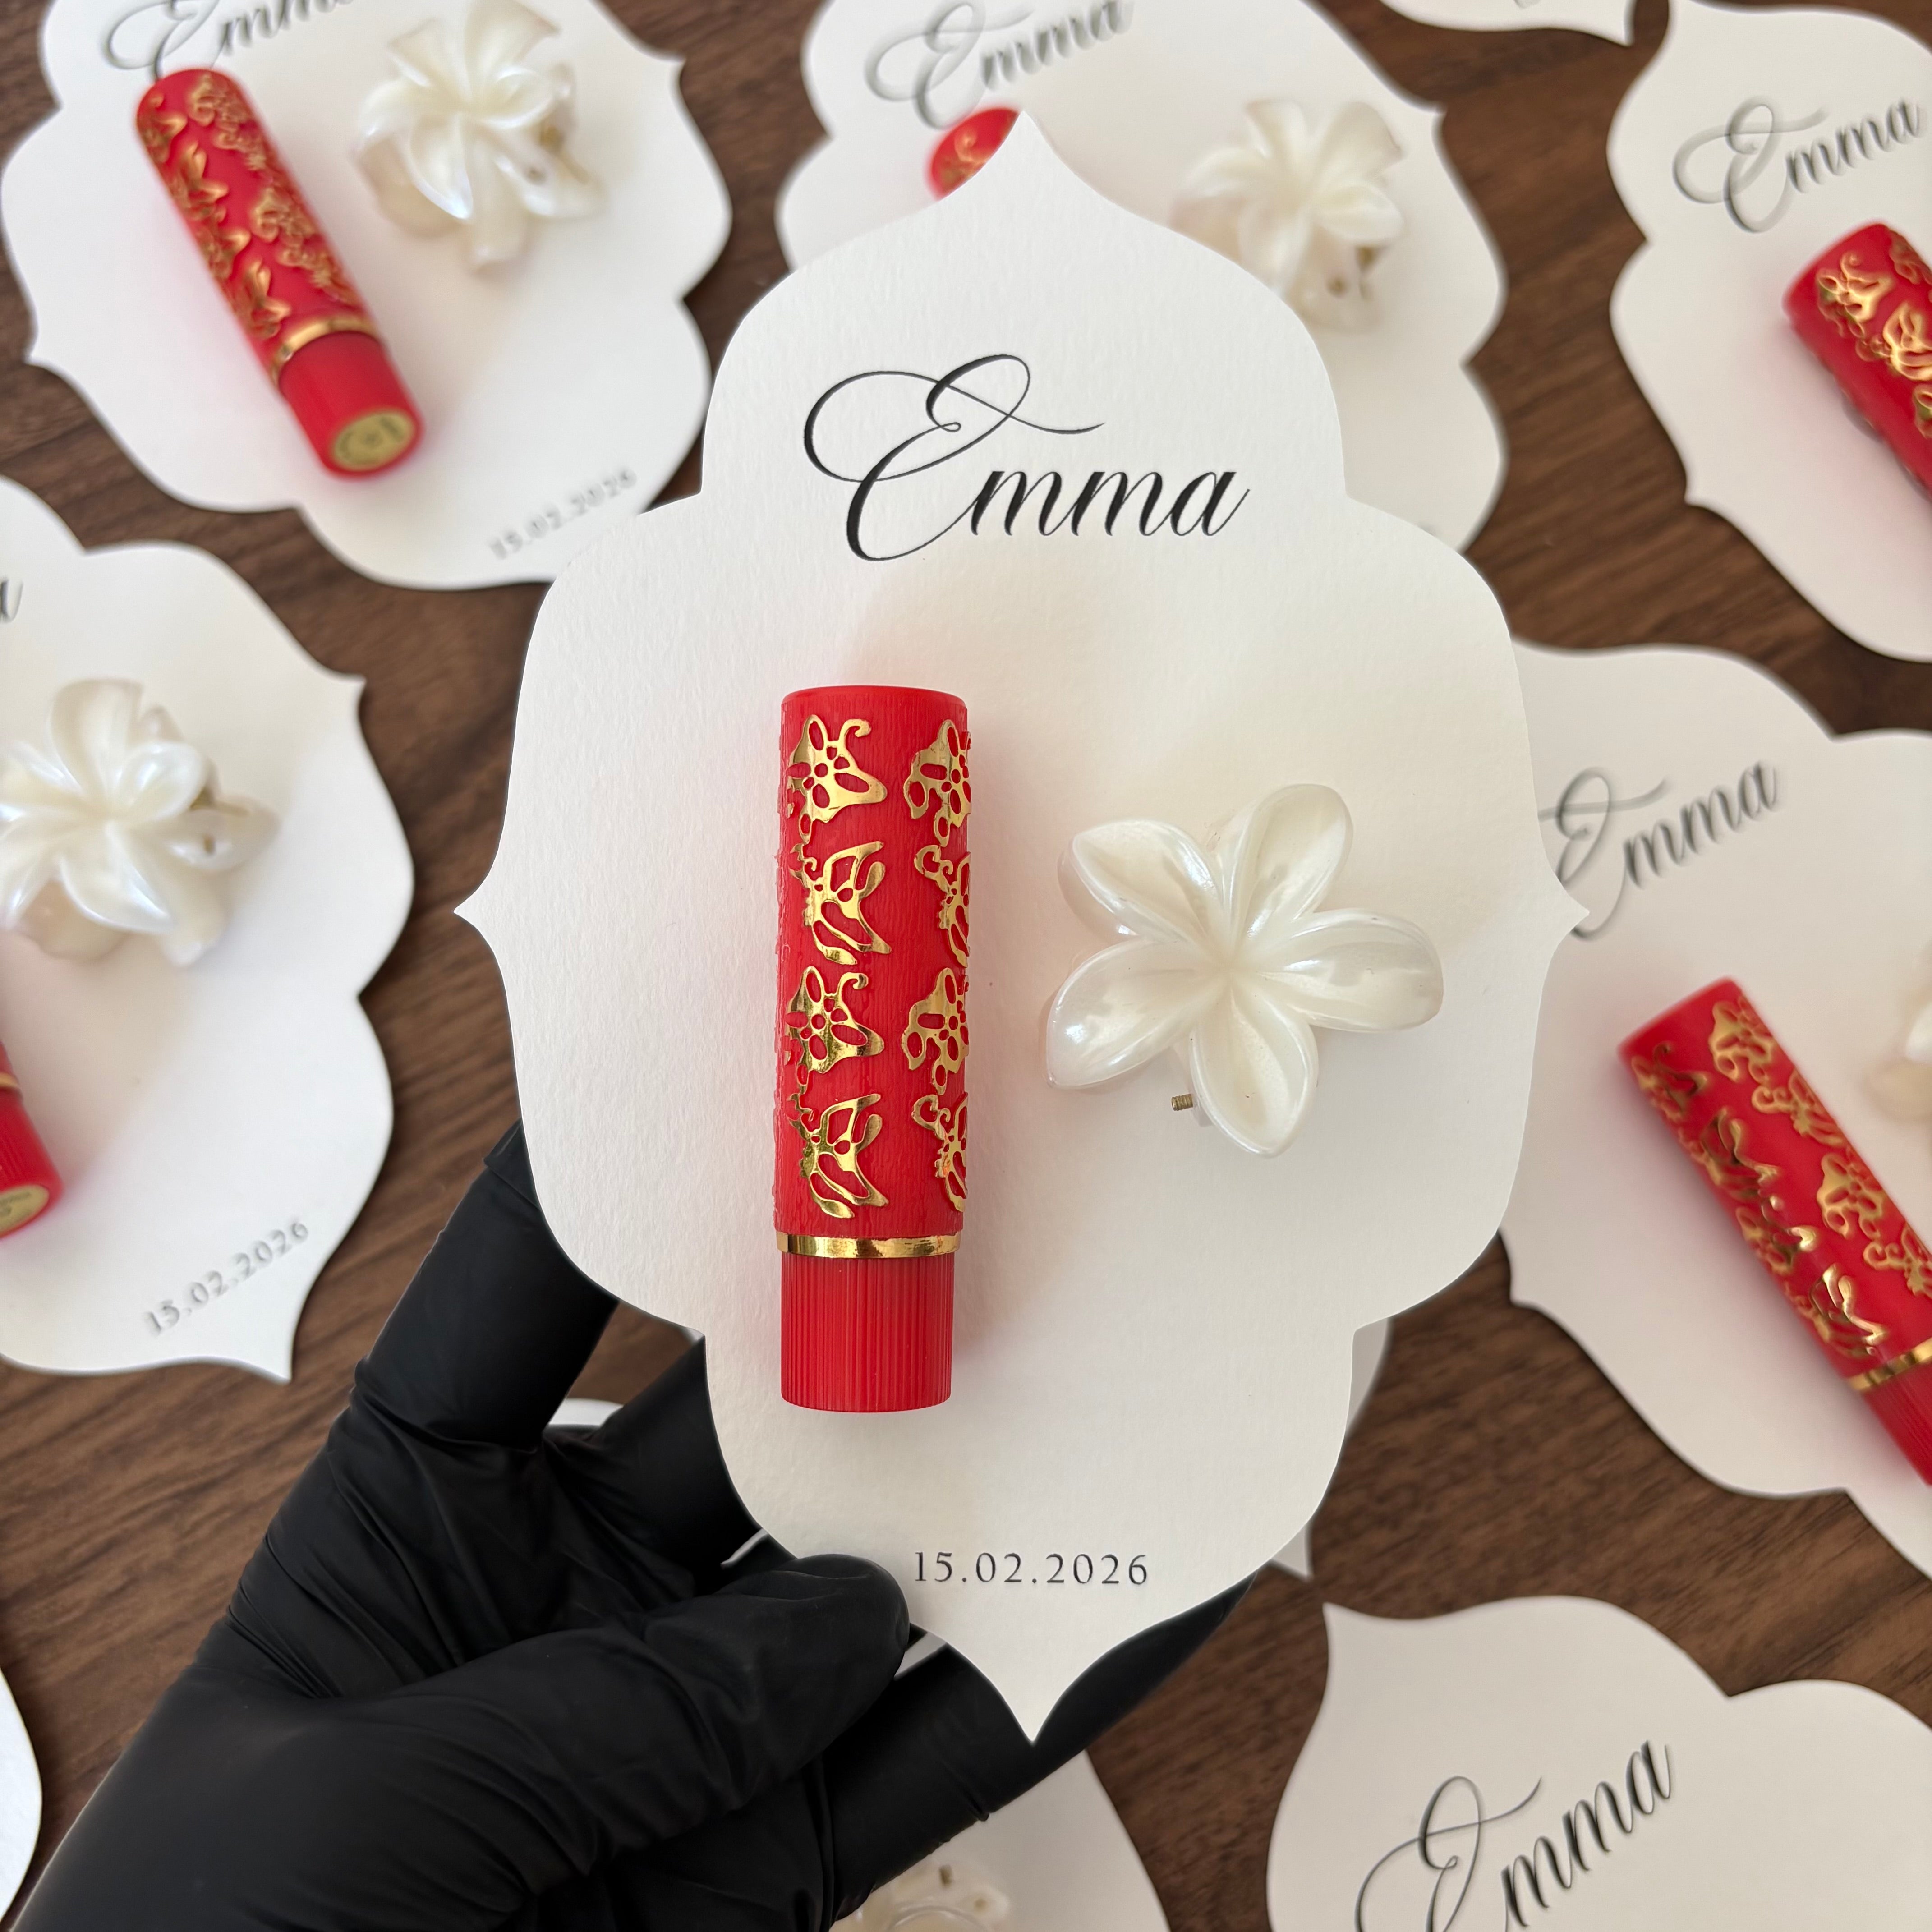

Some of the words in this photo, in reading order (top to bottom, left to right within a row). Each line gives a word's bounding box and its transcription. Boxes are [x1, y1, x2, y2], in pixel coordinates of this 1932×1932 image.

[1671, 95, 1924, 234] Emma
[804, 354, 1250, 561] Emma
[144, 1217, 308, 1336] 15.02.2026
[915, 1552, 1147, 1585] 15.02.2026
[1354, 1740, 1671, 1932] Emma
